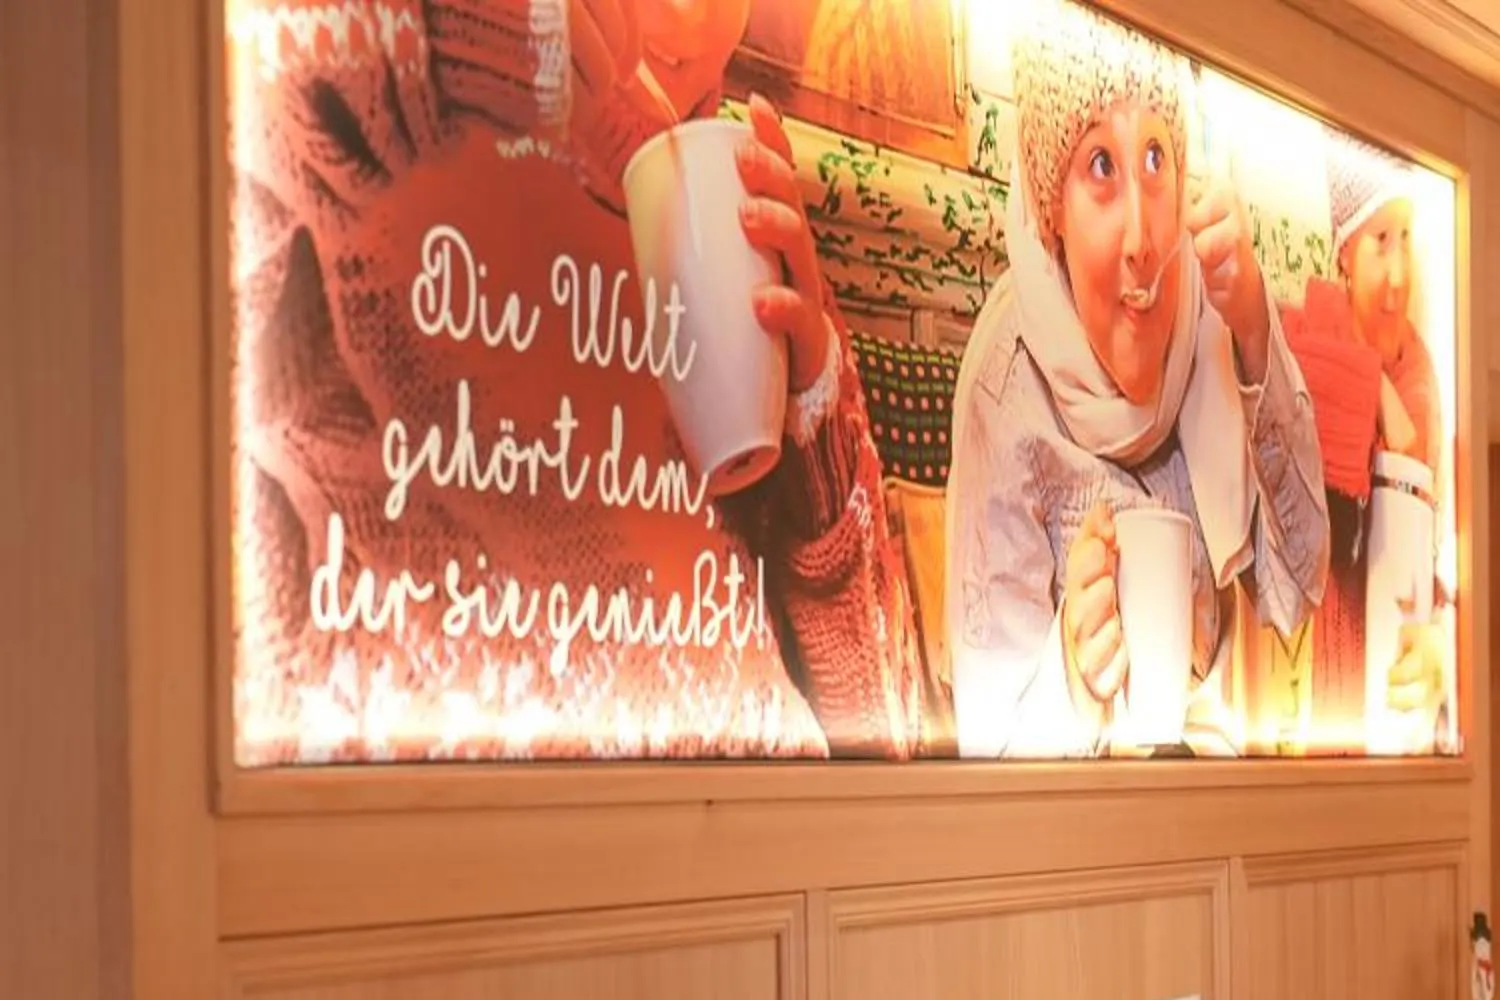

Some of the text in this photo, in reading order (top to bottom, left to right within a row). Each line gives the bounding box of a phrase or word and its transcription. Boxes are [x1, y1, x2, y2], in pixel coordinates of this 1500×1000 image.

[411, 224, 697, 381] Die Welt
[382, 379, 715, 529] gehört dem,
[310, 513, 764, 677] der sie genießt!
